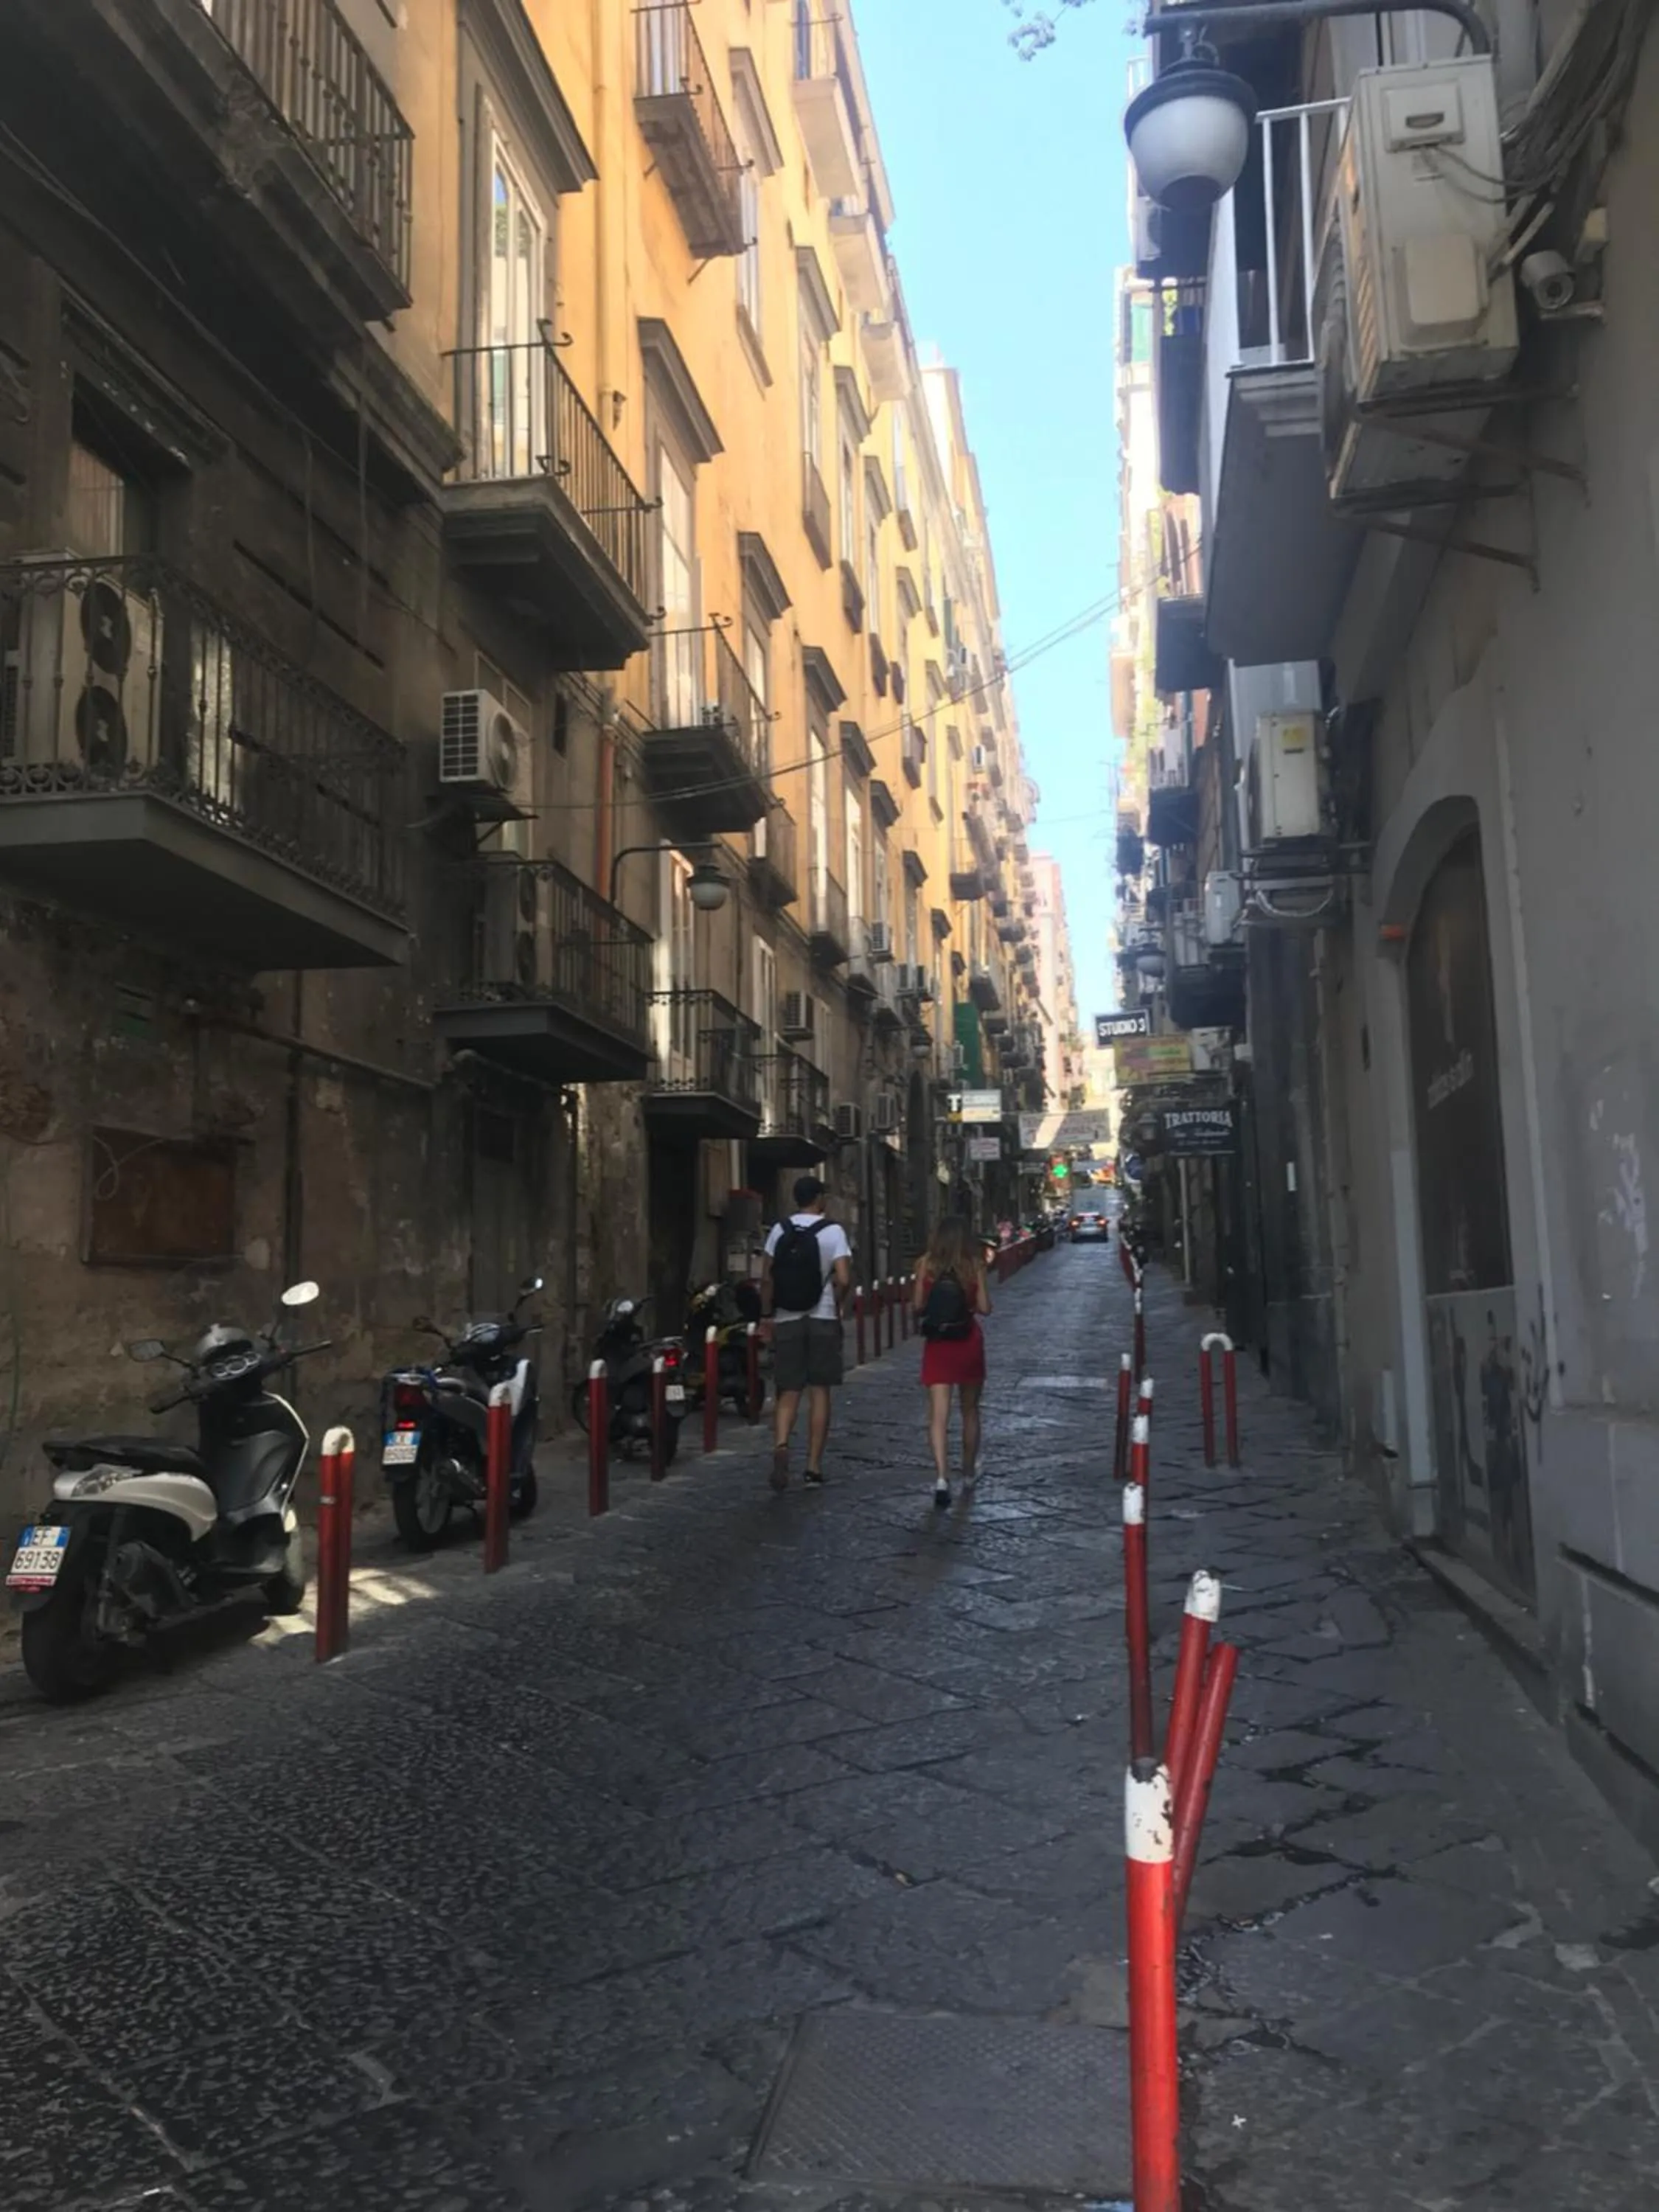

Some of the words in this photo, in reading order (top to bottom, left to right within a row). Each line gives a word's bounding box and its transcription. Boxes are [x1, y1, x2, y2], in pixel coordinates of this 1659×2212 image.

[1099, 1019, 1138, 1037] STUDIO
[1138, 1018, 1147, 1032] 3
[1164, 1110, 1234, 1130] TRATTORIA
[15, 1551, 60, 1570] 69138
